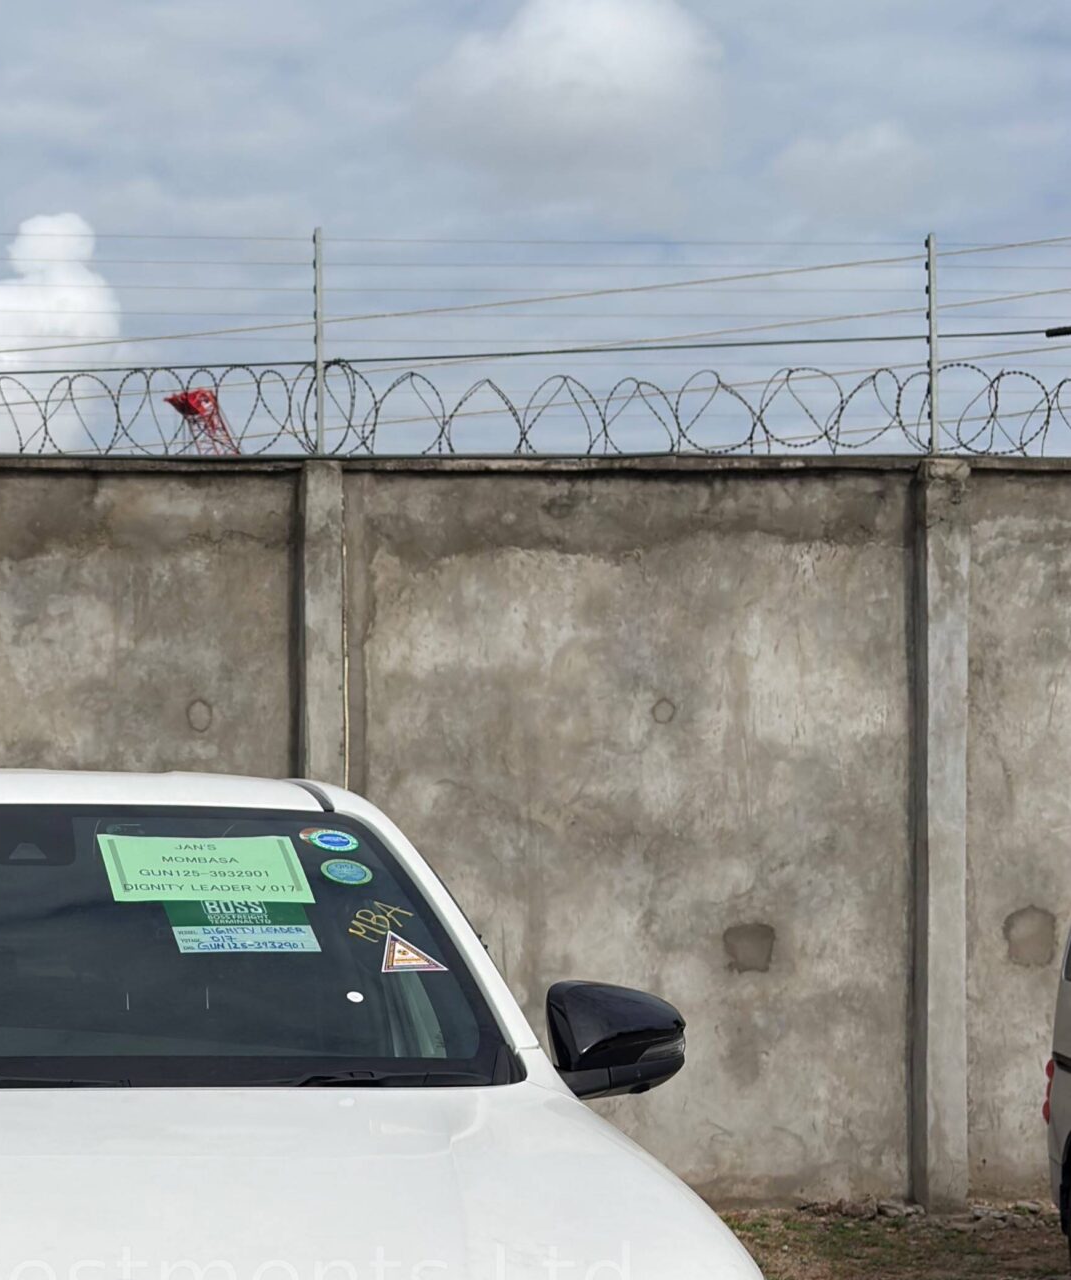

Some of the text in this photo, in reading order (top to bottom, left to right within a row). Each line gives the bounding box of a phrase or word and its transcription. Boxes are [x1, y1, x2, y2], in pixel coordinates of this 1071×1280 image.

[174, 843, 217, 851] JAN'S
[161, 855, 239, 864] MOMBASA
[138, 868, 270, 878] GUN125-3932901
[123, 883, 186, 892] DIGNITY
[190, 884, 251, 892] LEADER
[205, 900, 263, 914] BOSS
[348, 900, 414, 943] MBA
[202, 926, 307, 935] DIGNITY LEADER
